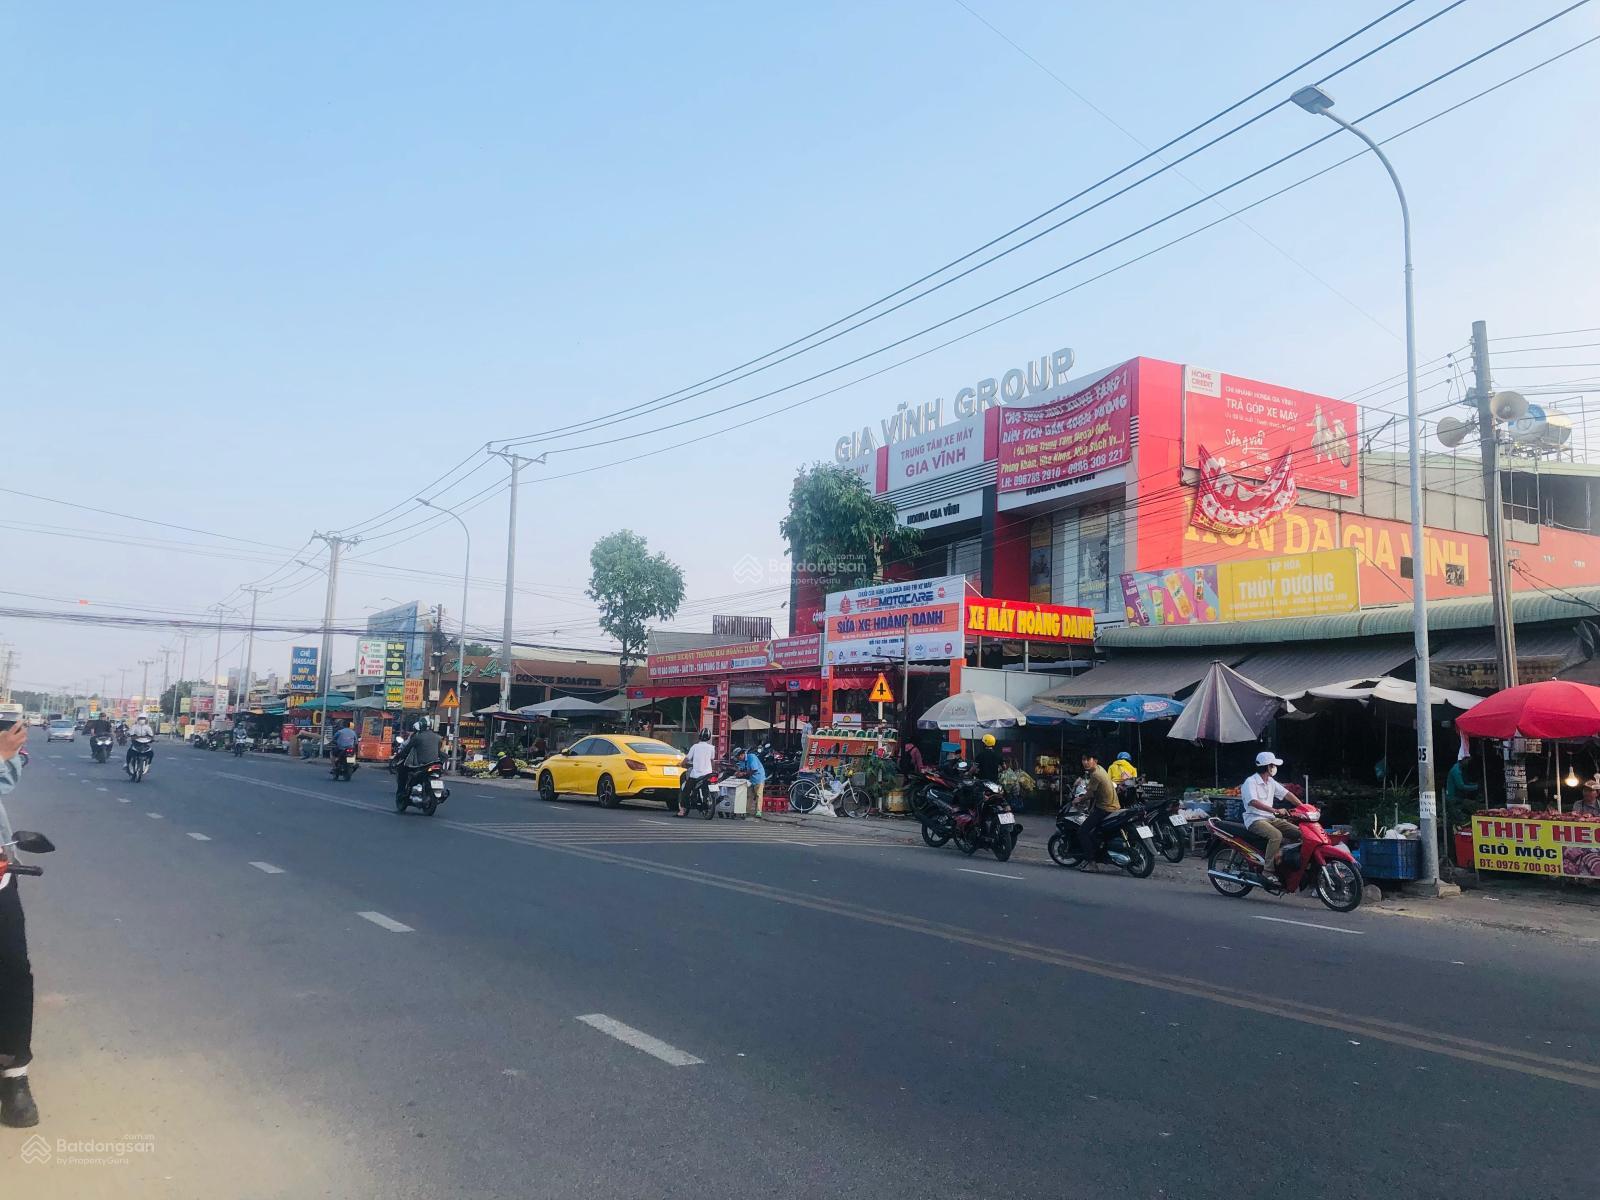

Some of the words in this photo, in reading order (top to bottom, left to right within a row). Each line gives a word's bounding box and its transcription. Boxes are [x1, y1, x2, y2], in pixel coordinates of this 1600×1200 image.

[835, 426, 878, 464] GIA
[881, 399, 945, 446] VĨNH
[953, 348, 1075, 420] GROUP
[1246, 402, 1264, 415] GÓP
[1266, 406, 1278, 418] XE
[1279, 408, 1299, 421] MÁY
[901, 445, 925, 460] TRUNG
[926, 437, 942, 452] TÂM
[944, 434, 955, 446] XE
[956, 426, 974, 442] MÁY
[905, 459, 929, 477] GIA
[931, 447, 966, 470] VĨNH
[1108, 448, 1124, 463] 221
[906, 511, 930, 525] HONDA
[930, 508, 943, 519] GIA
[858, 619, 871, 632] XE
[874, 612, 909, 631] HOÀNG
[912, 609, 945, 627] DANH
[968, 605, 986, 630] XE
[986, 602, 1015, 633] MÁY
[1017, 604, 1061, 637] HOÀNG
[1061, 613, 1095, 640] DANH
[1477, 820, 1541, 843] THỊT
[1479, 843, 1509, 856] GIÒ
[1515, 845, 1558, 861] MỘC
[1479, 858, 1494, 869] ĐT:
[1496, 860, 1520, 870] 0976
[1524, 862, 1541, 872] 700
